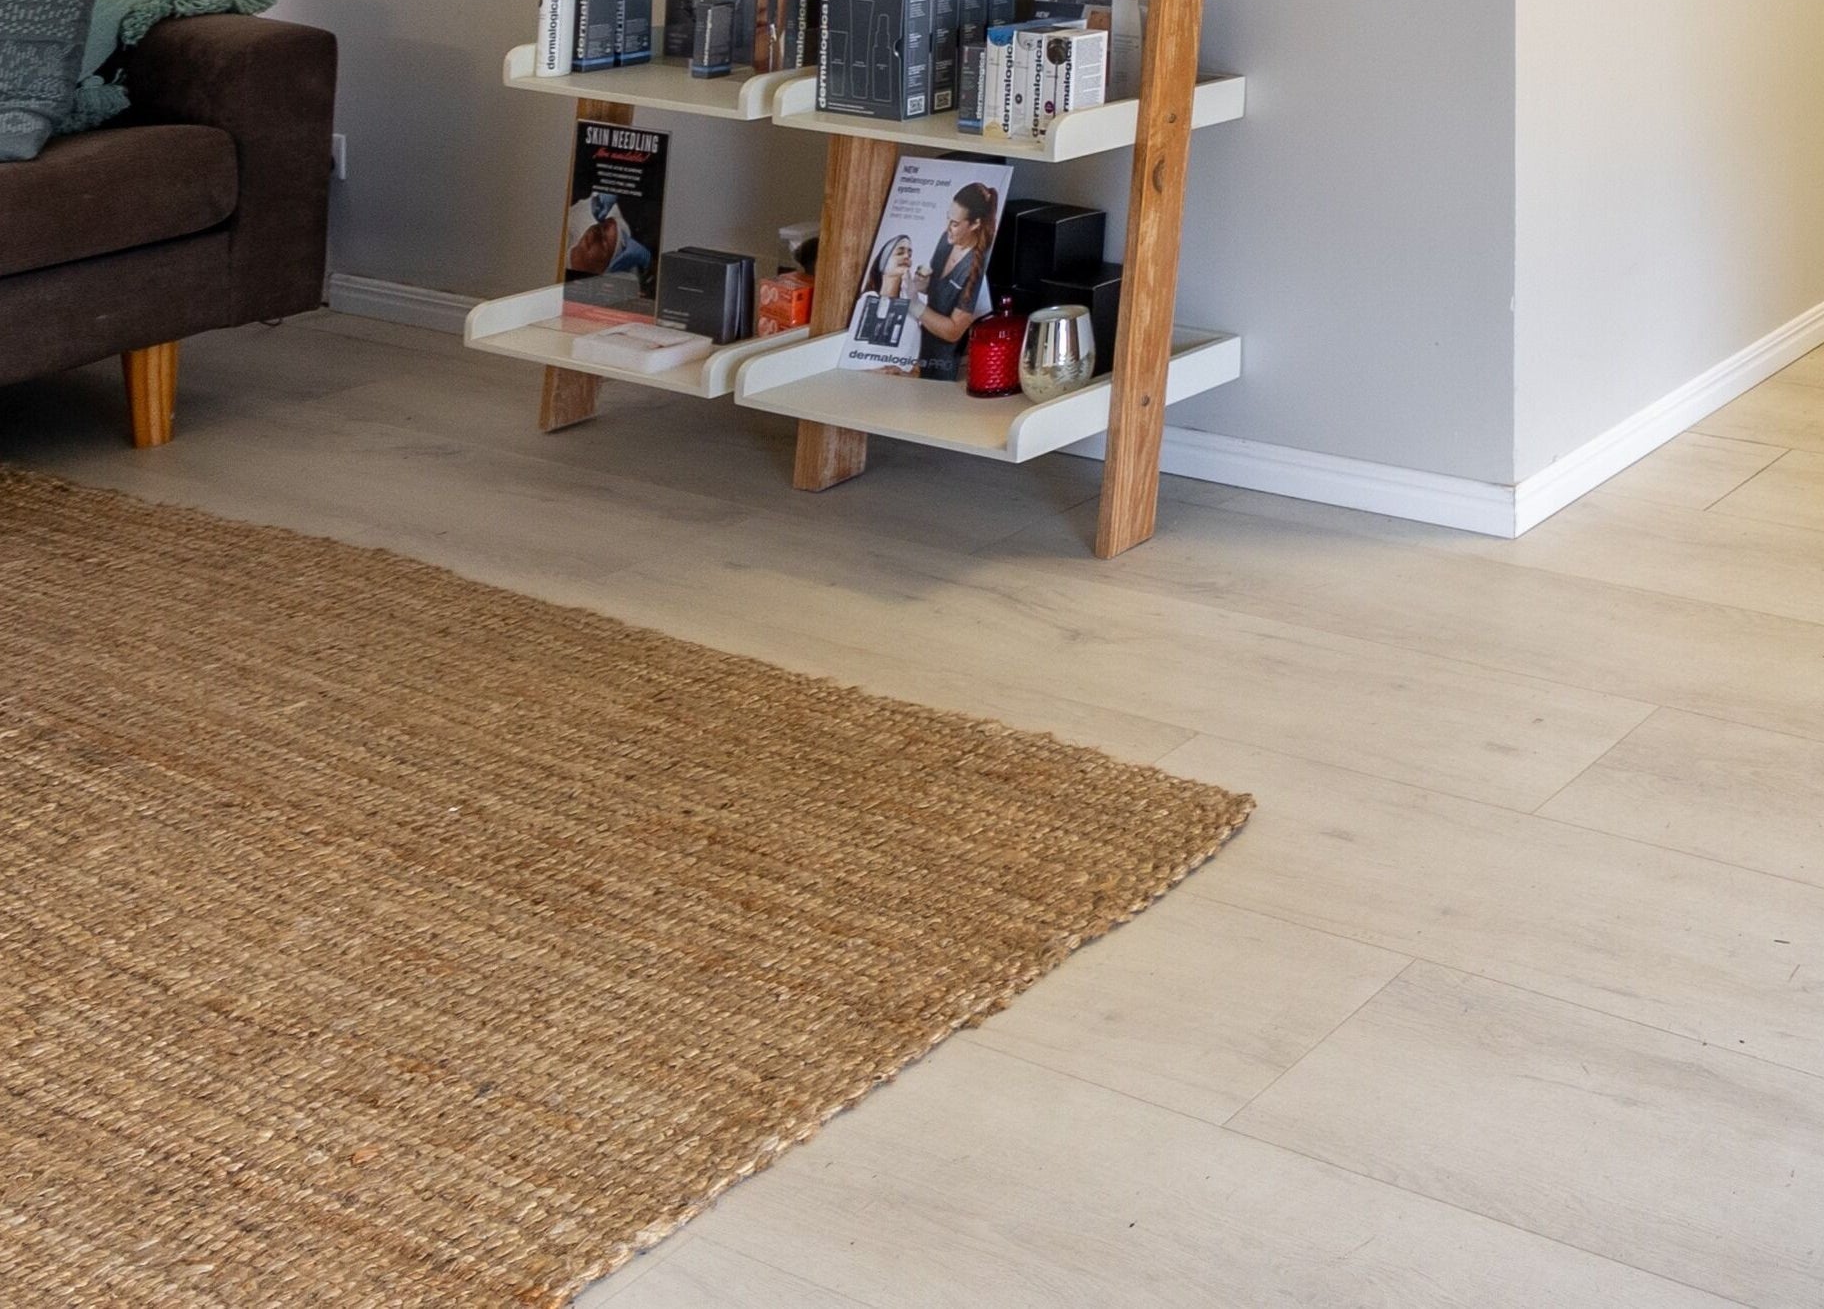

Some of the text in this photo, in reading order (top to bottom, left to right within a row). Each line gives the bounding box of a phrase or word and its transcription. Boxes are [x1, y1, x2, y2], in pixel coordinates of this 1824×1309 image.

[819, 3, 829, 108] dermalogica
[1031, 39, 1043, 137] dermalogica
[586, 126, 659, 154] SKIN NEEDLING
[849, 349, 928, 370] dermalogica
